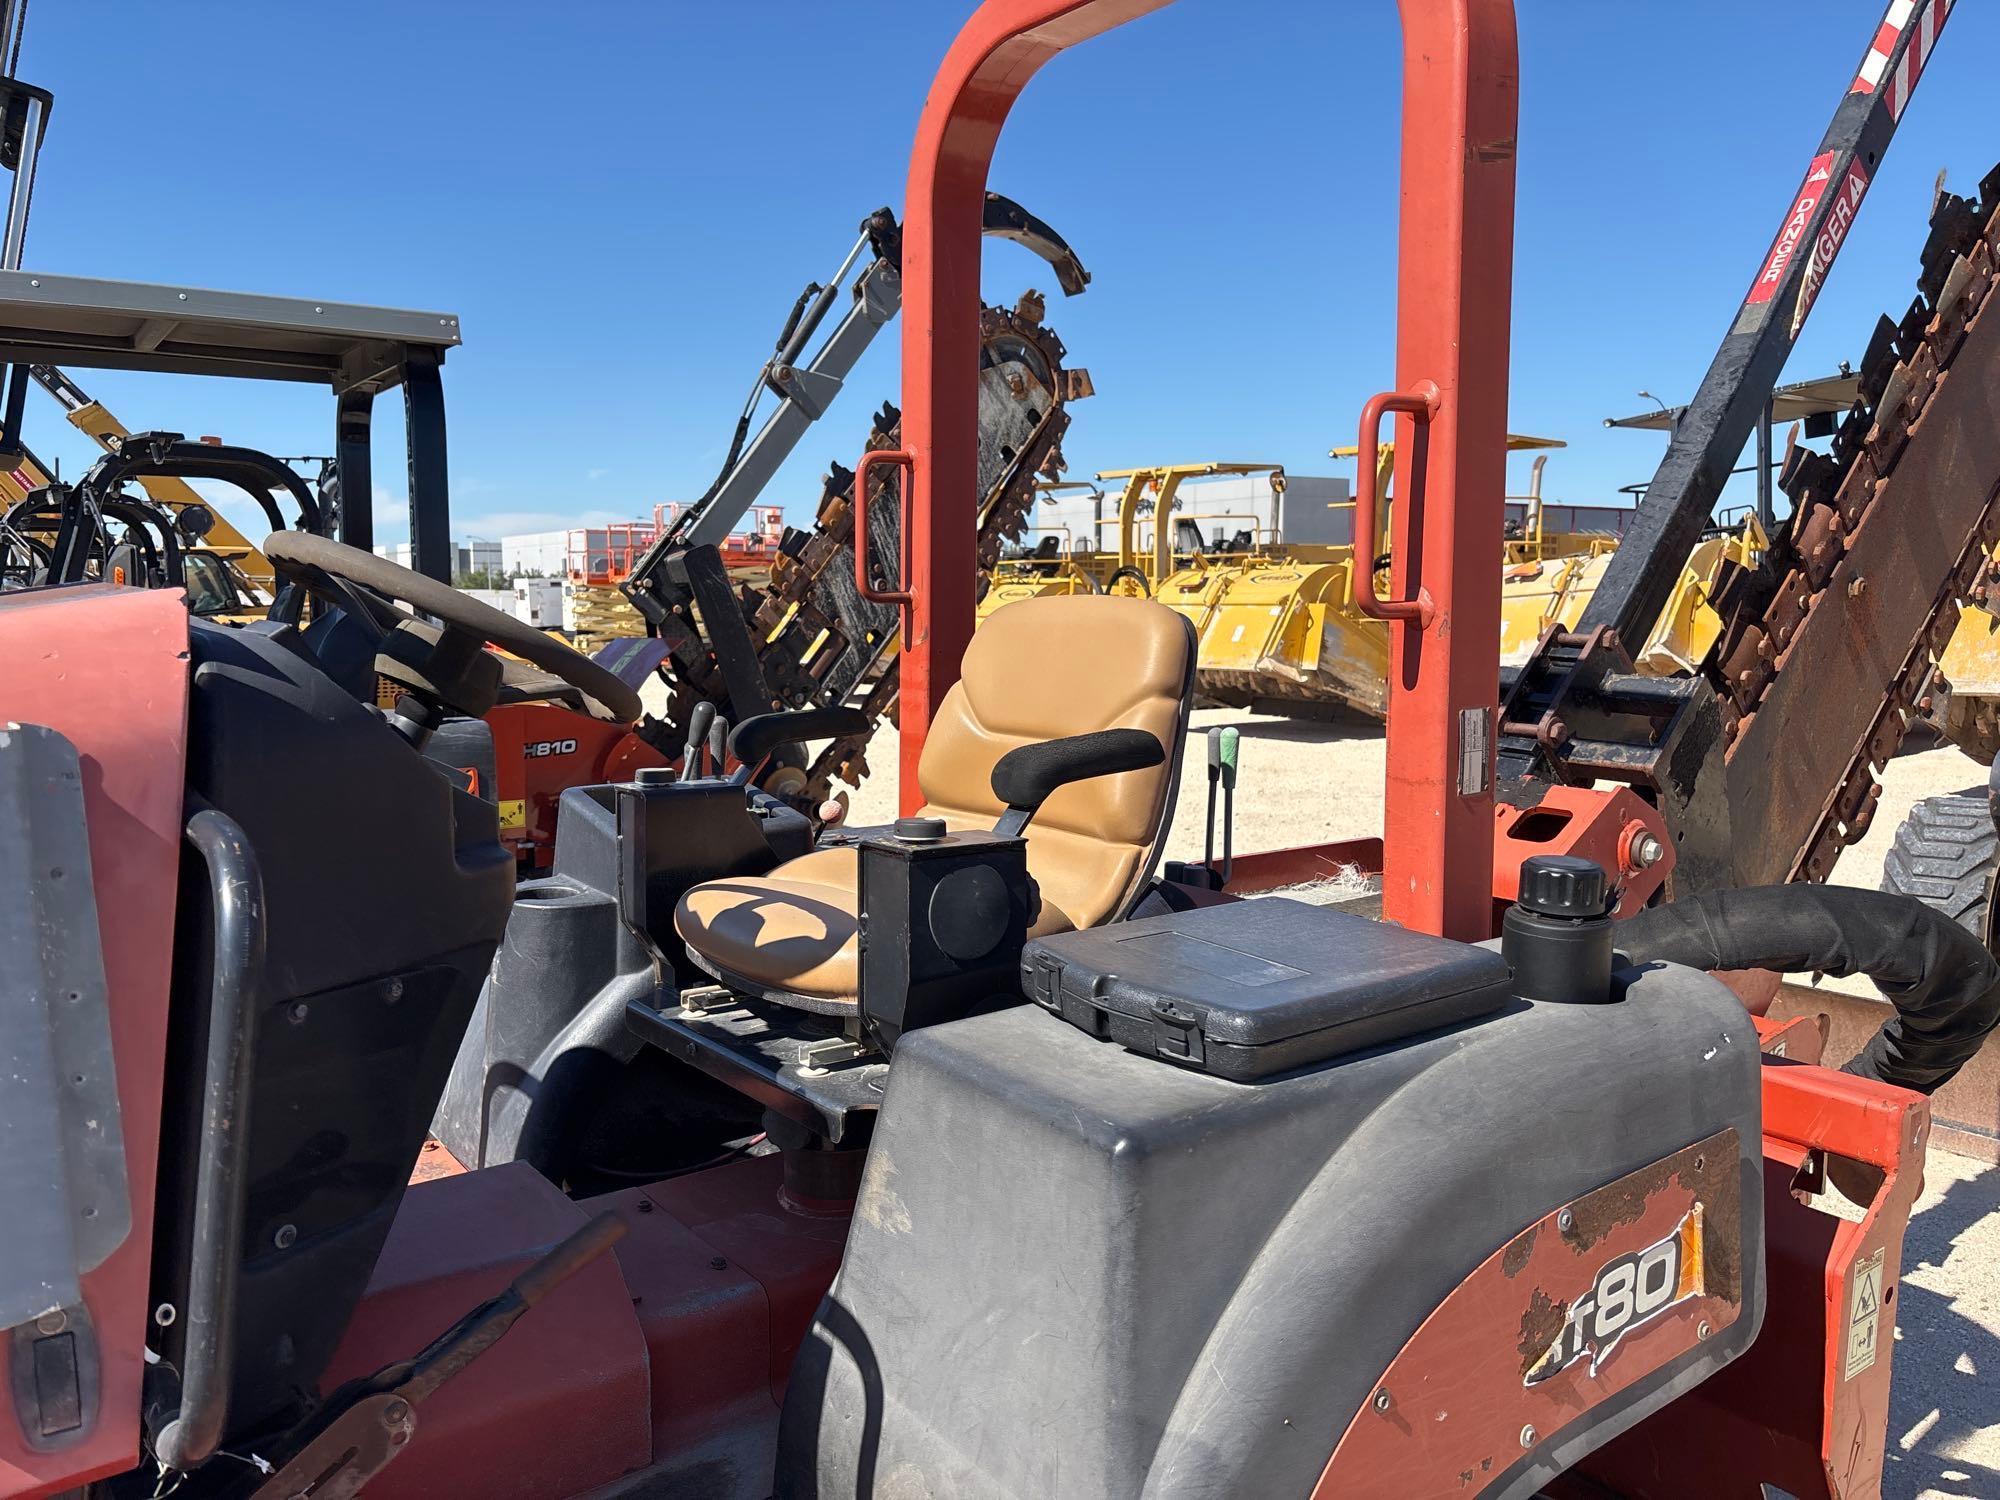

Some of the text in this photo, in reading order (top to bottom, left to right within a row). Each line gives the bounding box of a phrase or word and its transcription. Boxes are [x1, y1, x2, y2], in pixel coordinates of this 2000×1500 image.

[1762, 198, 1814, 284] DANGER
[1801, 196, 1851, 316] ANGER
[107, 435, 122, 451] CA
[523, 738, 577, 759] H810
